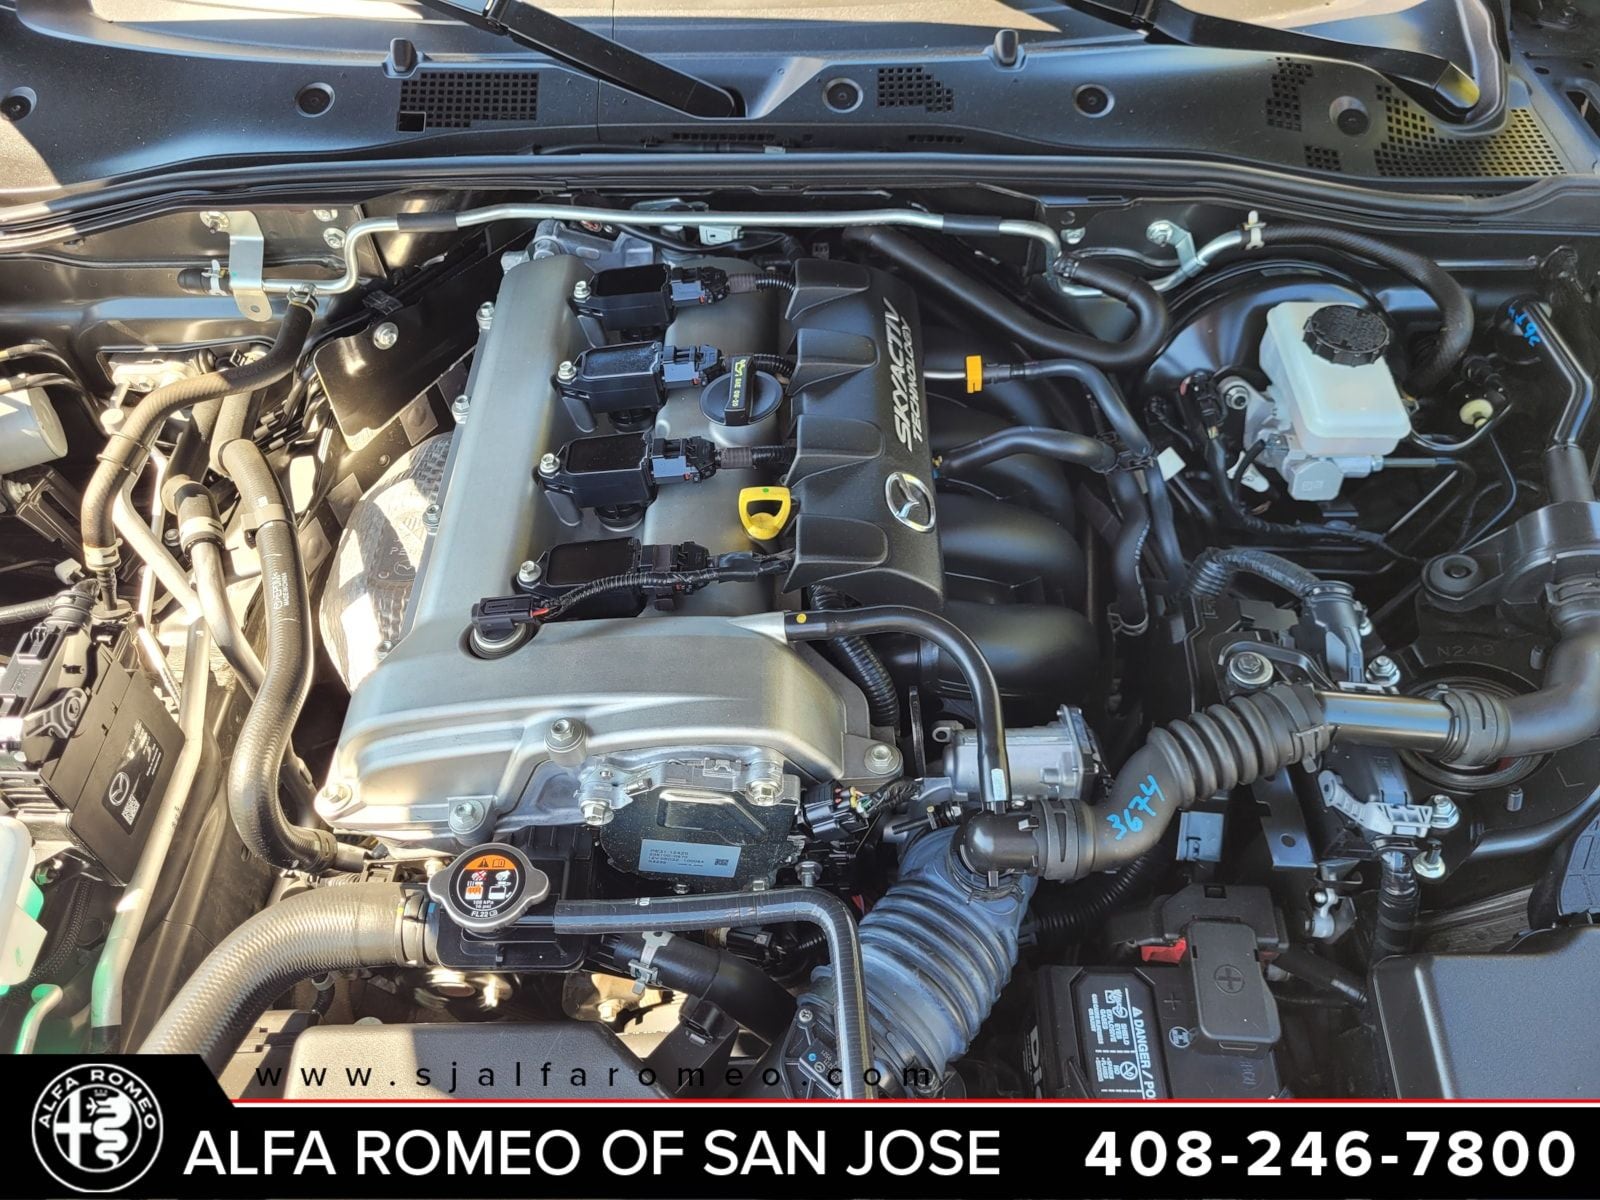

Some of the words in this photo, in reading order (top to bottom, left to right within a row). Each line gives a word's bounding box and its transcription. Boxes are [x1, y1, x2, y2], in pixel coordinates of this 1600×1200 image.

[883, 297, 913, 453] SKYACTIV
[901, 315, 923, 443] TECHNOLOGY
[1106, 774, 1166, 840] 3674
[471, 910, 489, 918] FL22
[1133, 1019, 1152, 1069] DANGER
